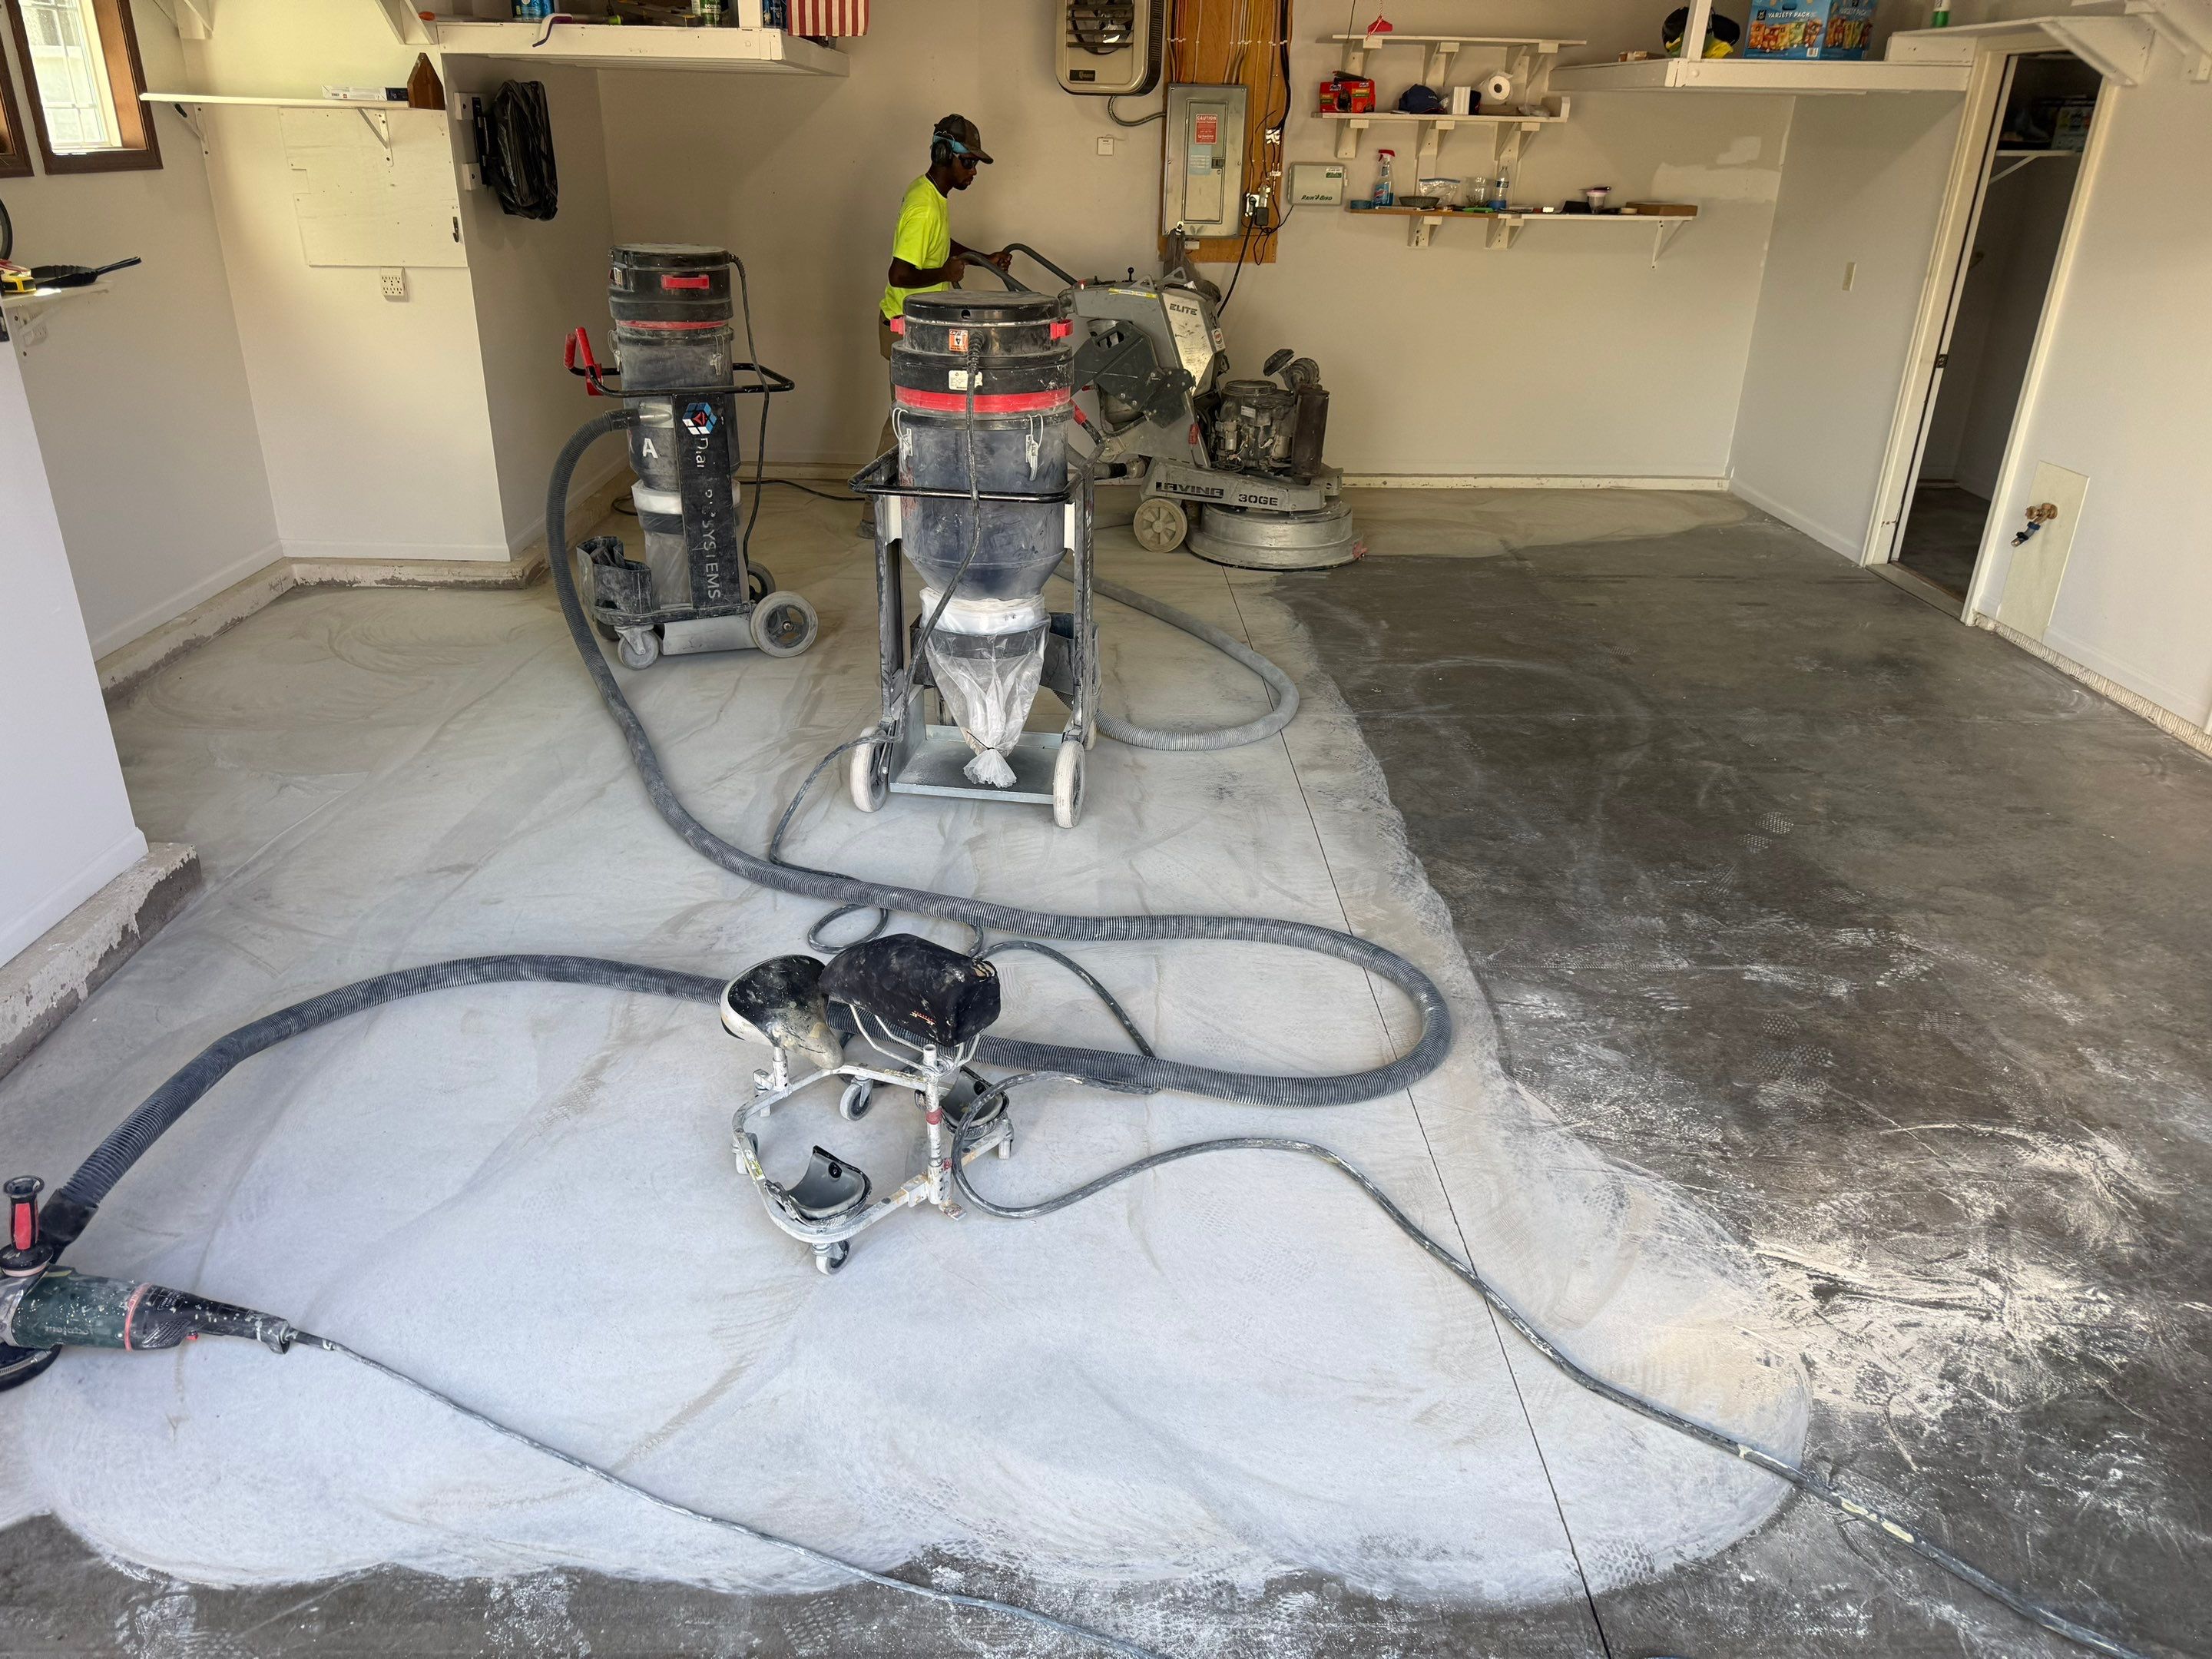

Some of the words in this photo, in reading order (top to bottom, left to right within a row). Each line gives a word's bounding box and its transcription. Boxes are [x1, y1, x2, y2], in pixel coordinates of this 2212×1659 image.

[1169, 303, 1198, 316] ELITE
[642, 437, 659, 459] A
[1155, 481, 1224, 499] LAVINA
[1237, 493, 1279, 506] 30GE
